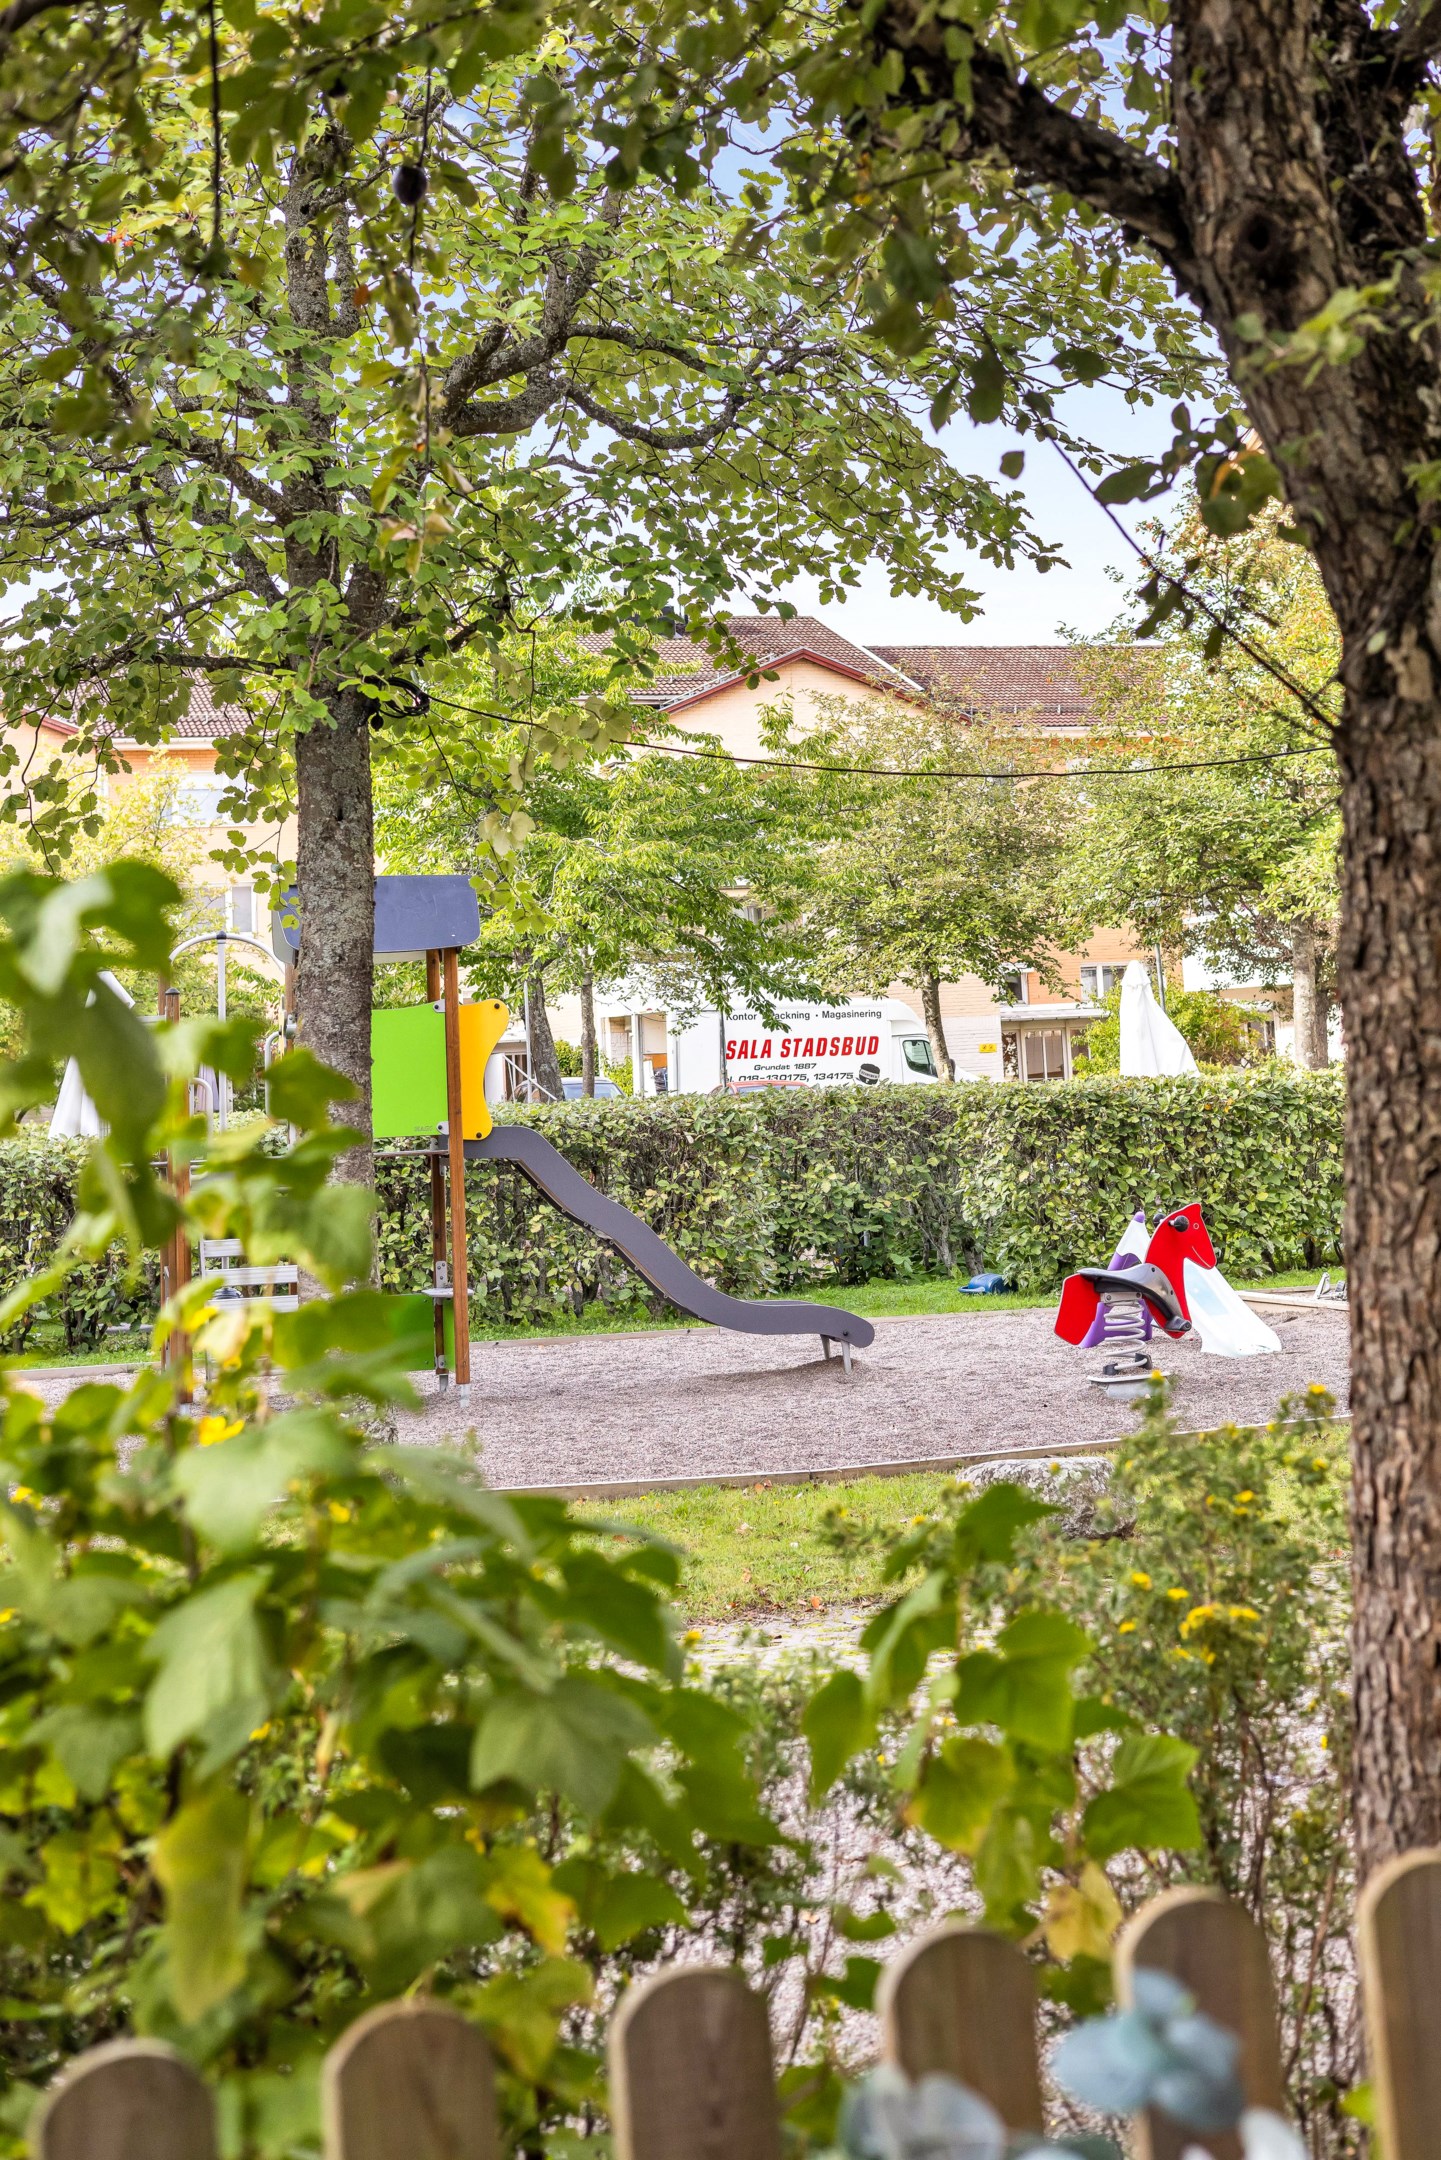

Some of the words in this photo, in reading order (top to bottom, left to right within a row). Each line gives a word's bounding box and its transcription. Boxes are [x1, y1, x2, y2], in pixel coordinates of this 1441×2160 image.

[726, 1012, 757, 1021] Kontor
[770, 1011, 810, 1021] ackning
[822, 1010, 882, 1021] Magasinering
[725, 1039, 772, 1060] SALA
[780, 1036, 879, 1058] STADSBUD
[813, 1072, 854, 1081] 134175
